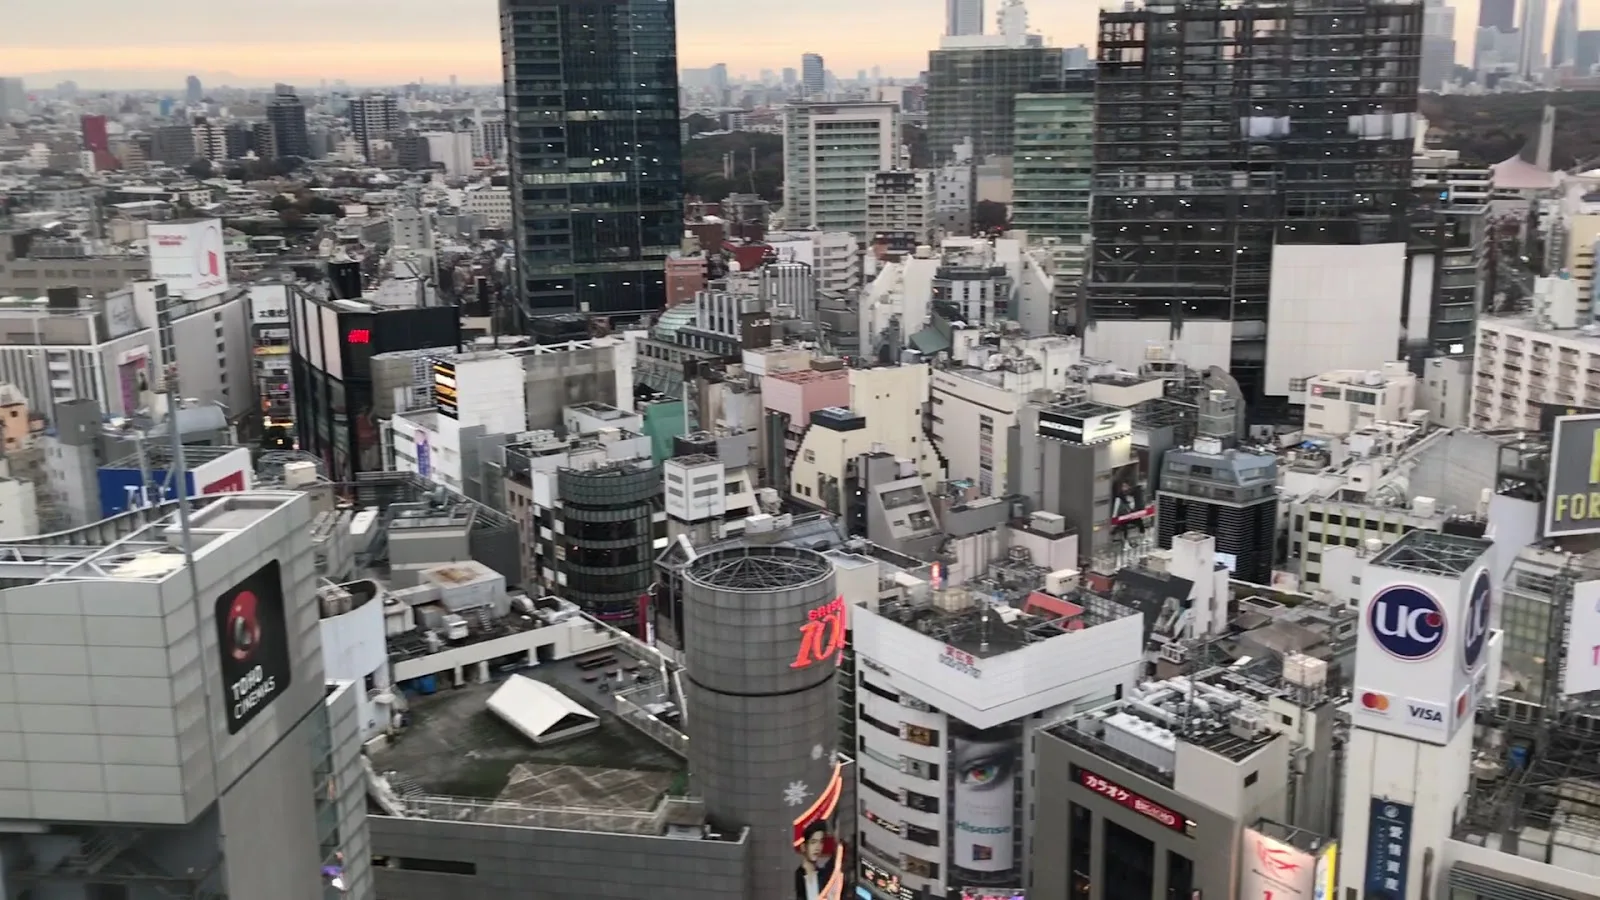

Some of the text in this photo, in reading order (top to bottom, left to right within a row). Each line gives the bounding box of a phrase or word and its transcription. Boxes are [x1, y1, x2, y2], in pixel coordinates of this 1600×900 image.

[1376, 600, 1441, 643] UC
[231, 665, 263, 701] TOHO
[234, 675, 276, 720] CINEMAS
[1408, 704, 1443, 722] VISA
[1086, 775, 1130, 801] カラオケ
[955, 820, 1011, 835] Hisense
